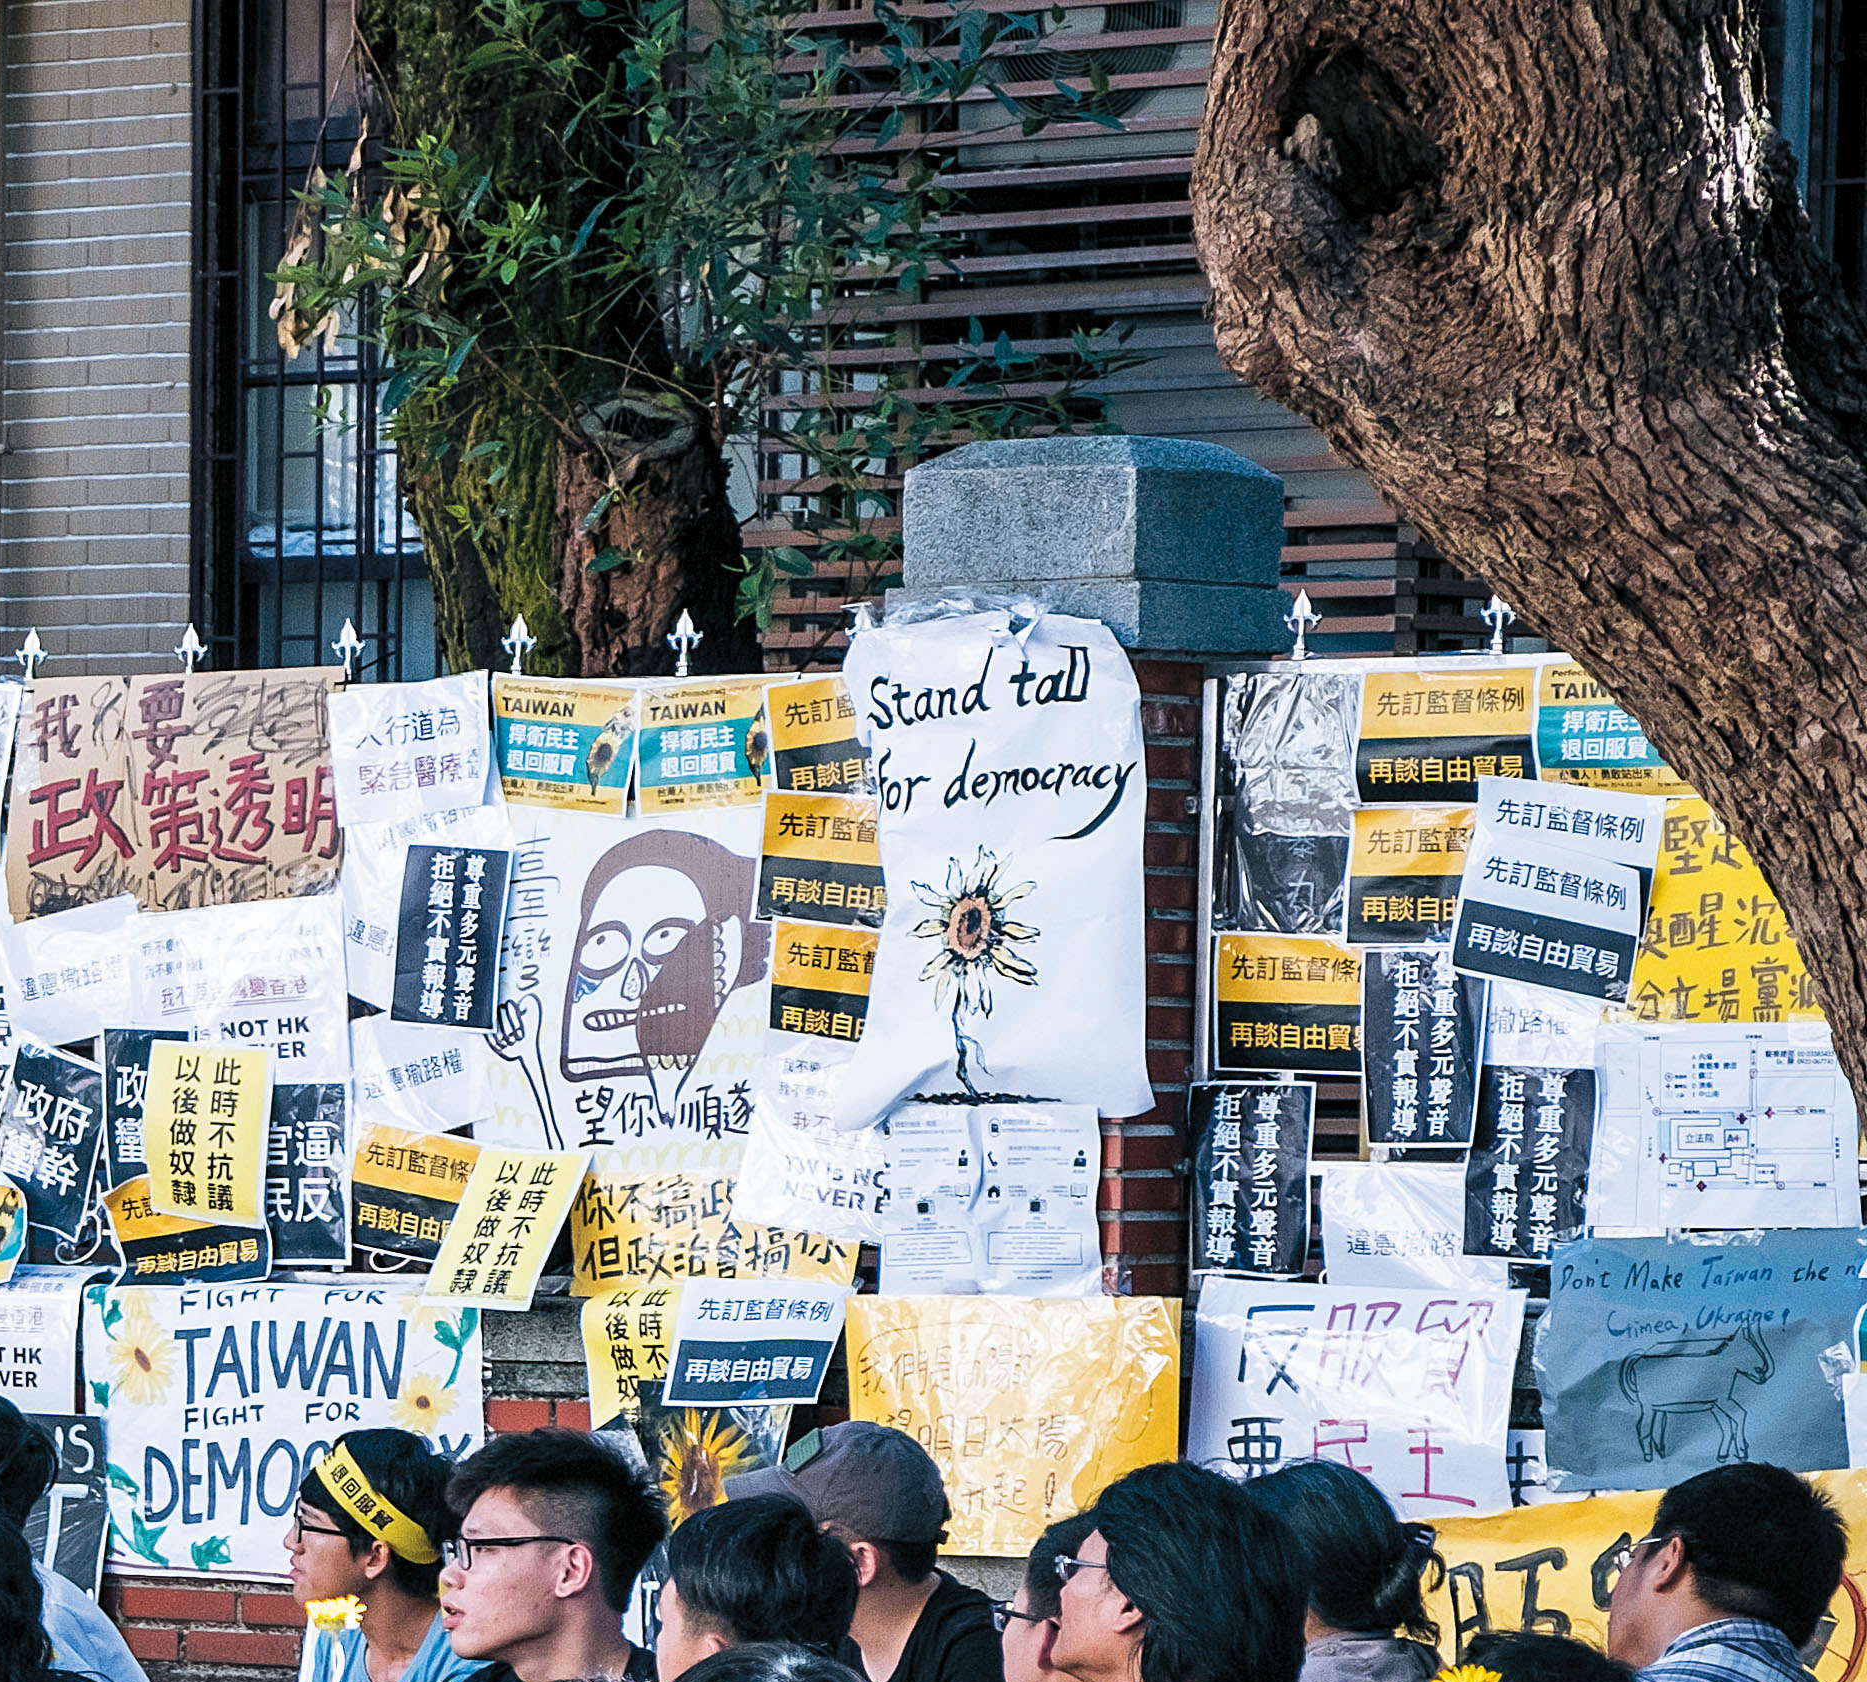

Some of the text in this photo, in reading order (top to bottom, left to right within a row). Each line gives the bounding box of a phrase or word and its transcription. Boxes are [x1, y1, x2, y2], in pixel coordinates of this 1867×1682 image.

[502, 696, 575, 718] TAIWAN
[649, 700, 727, 722] TAIWAN
[866, 643, 1090, 731] Stand tall
[1377, 684, 1525, 719] 先訂監督條例
[1561, 736, 1650, 762] 退回服貿
[27, 753, 338, 874] 政策透明
[942, 738, 1138, 842] democracy
[1495, 797, 1645, 844] 先訂監督條例
[1483, 855, 1627, 911] 先訂監督條例
[417, 852, 458, 1020] 拒絕不實報導
[452, 854, 488, 1022] 尊重多元聲音
[1466, 921, 1620, 981] 再談自由貿易
[1391, 957, 1421, 1139] 拒絕不實報導
[13, 1078, 95, 1146] 政府
[169, 1053, 202, 1208] 以後做奴隸
[207, 1056, 243, 1212] 此時不抗議
[1206, 1091, 1242, 1265] 拒絕不實報導
[1249, 1092, 1283, 1267] 尊重多元聲音
[1489, 1072, 1526, 1251] 拒絕不實報導
[1530, 1073, 1567, 1258] 尊重多元聲音
[135, 1238, 260, 1276] 再談自由貿易
[449, 1159, 521, 1294] 以後做奴隸
[482, 1160, 558, 1295] 此時不抗議
[180, 1287, 386, 1316] FIGHT FOR
[696, 1297, 833, 1323] 先訂監督條例
[1559, 1255, 1831, 1293] Don't Make Taiwan the
[14, 1347, 43, 1366] HK
[173, 1316, 407, 1405] TAIWAN
[683, 1356, 814, 1384] 再談自由貿易
[184, 1401, 361, 1433] FIGHT FOR
